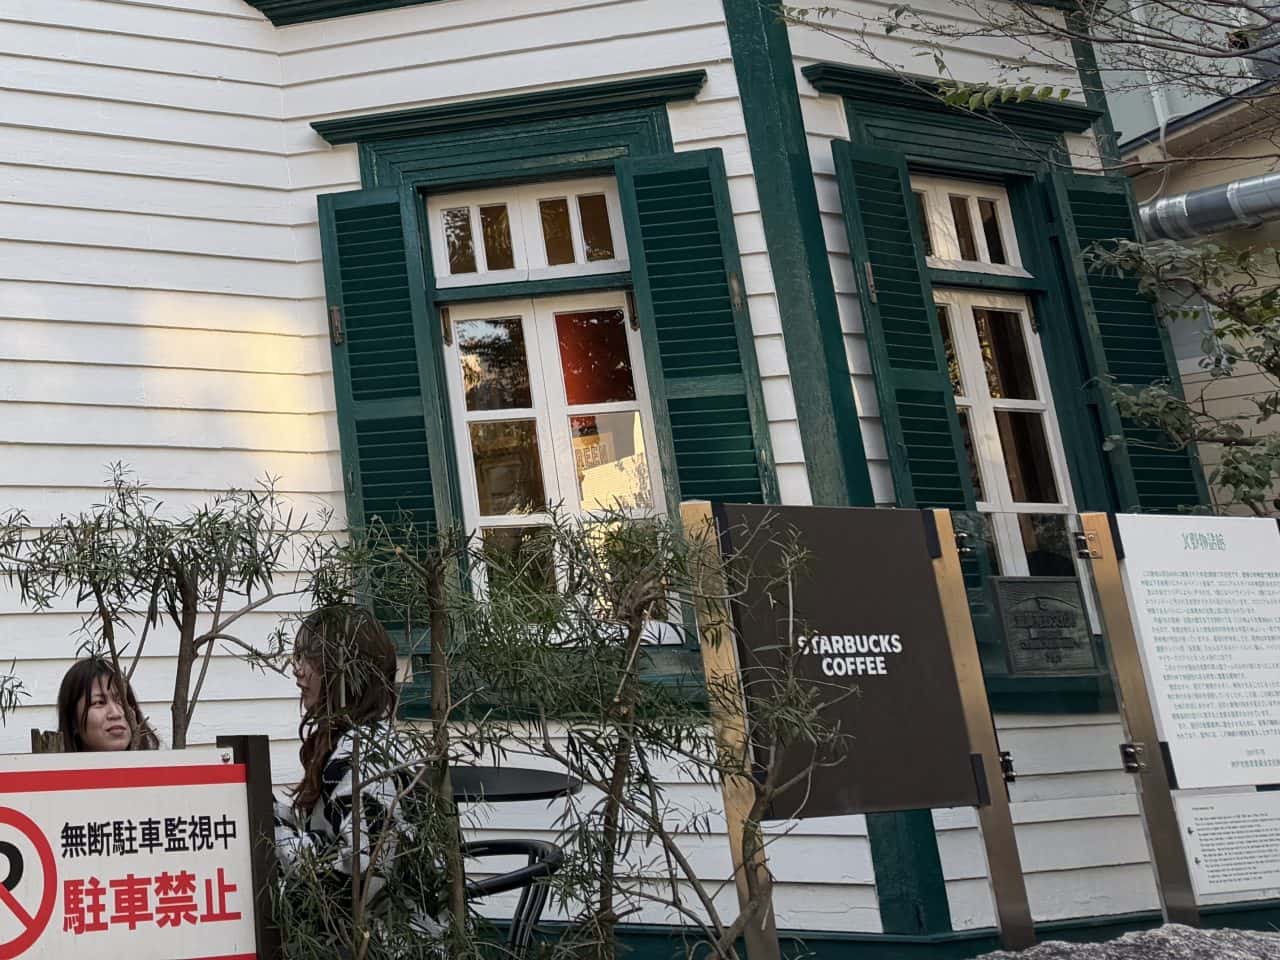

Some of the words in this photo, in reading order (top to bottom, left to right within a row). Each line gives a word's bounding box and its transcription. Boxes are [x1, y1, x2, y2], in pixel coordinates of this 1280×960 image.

[798, 634, 903, 655] STARBUCKS
[822, 656, 887, 677] COFFEE
[60, 815, 238, 859] 無断駐車監視中
[63, 868, 242, 935] 駐車禁止
